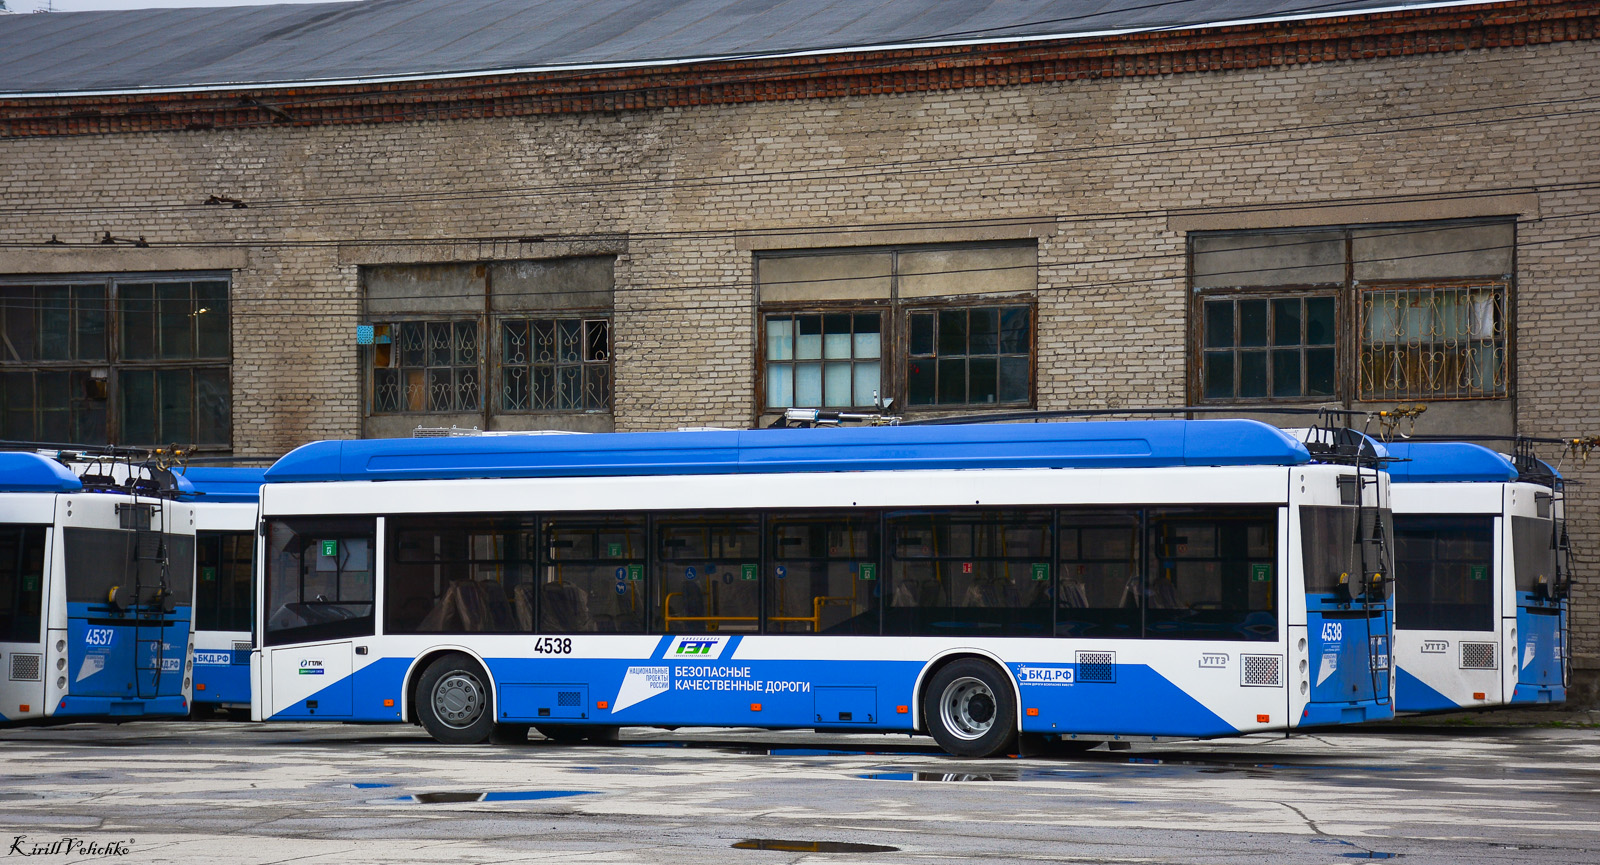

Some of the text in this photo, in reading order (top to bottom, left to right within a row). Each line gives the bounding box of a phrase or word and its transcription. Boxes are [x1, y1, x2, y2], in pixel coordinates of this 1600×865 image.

[85, 629, 114, 645] 4537
[1321, 623, 1342, 641] 4538
[534, 637, 572, 654] 4538
[198, 654, 229, 662] БКД.РФ
[629, 667, 668, 675] НАЦИОНАЛЬНЫЕ
[674, 666, 751, 678] БЕЗОПАСНЫЕ
[1028, 669, 1072, 681] БКД.РФ
[674, 679, 811, 694] КАЧЕСТВЕННЫЕ ДОРОГИ
